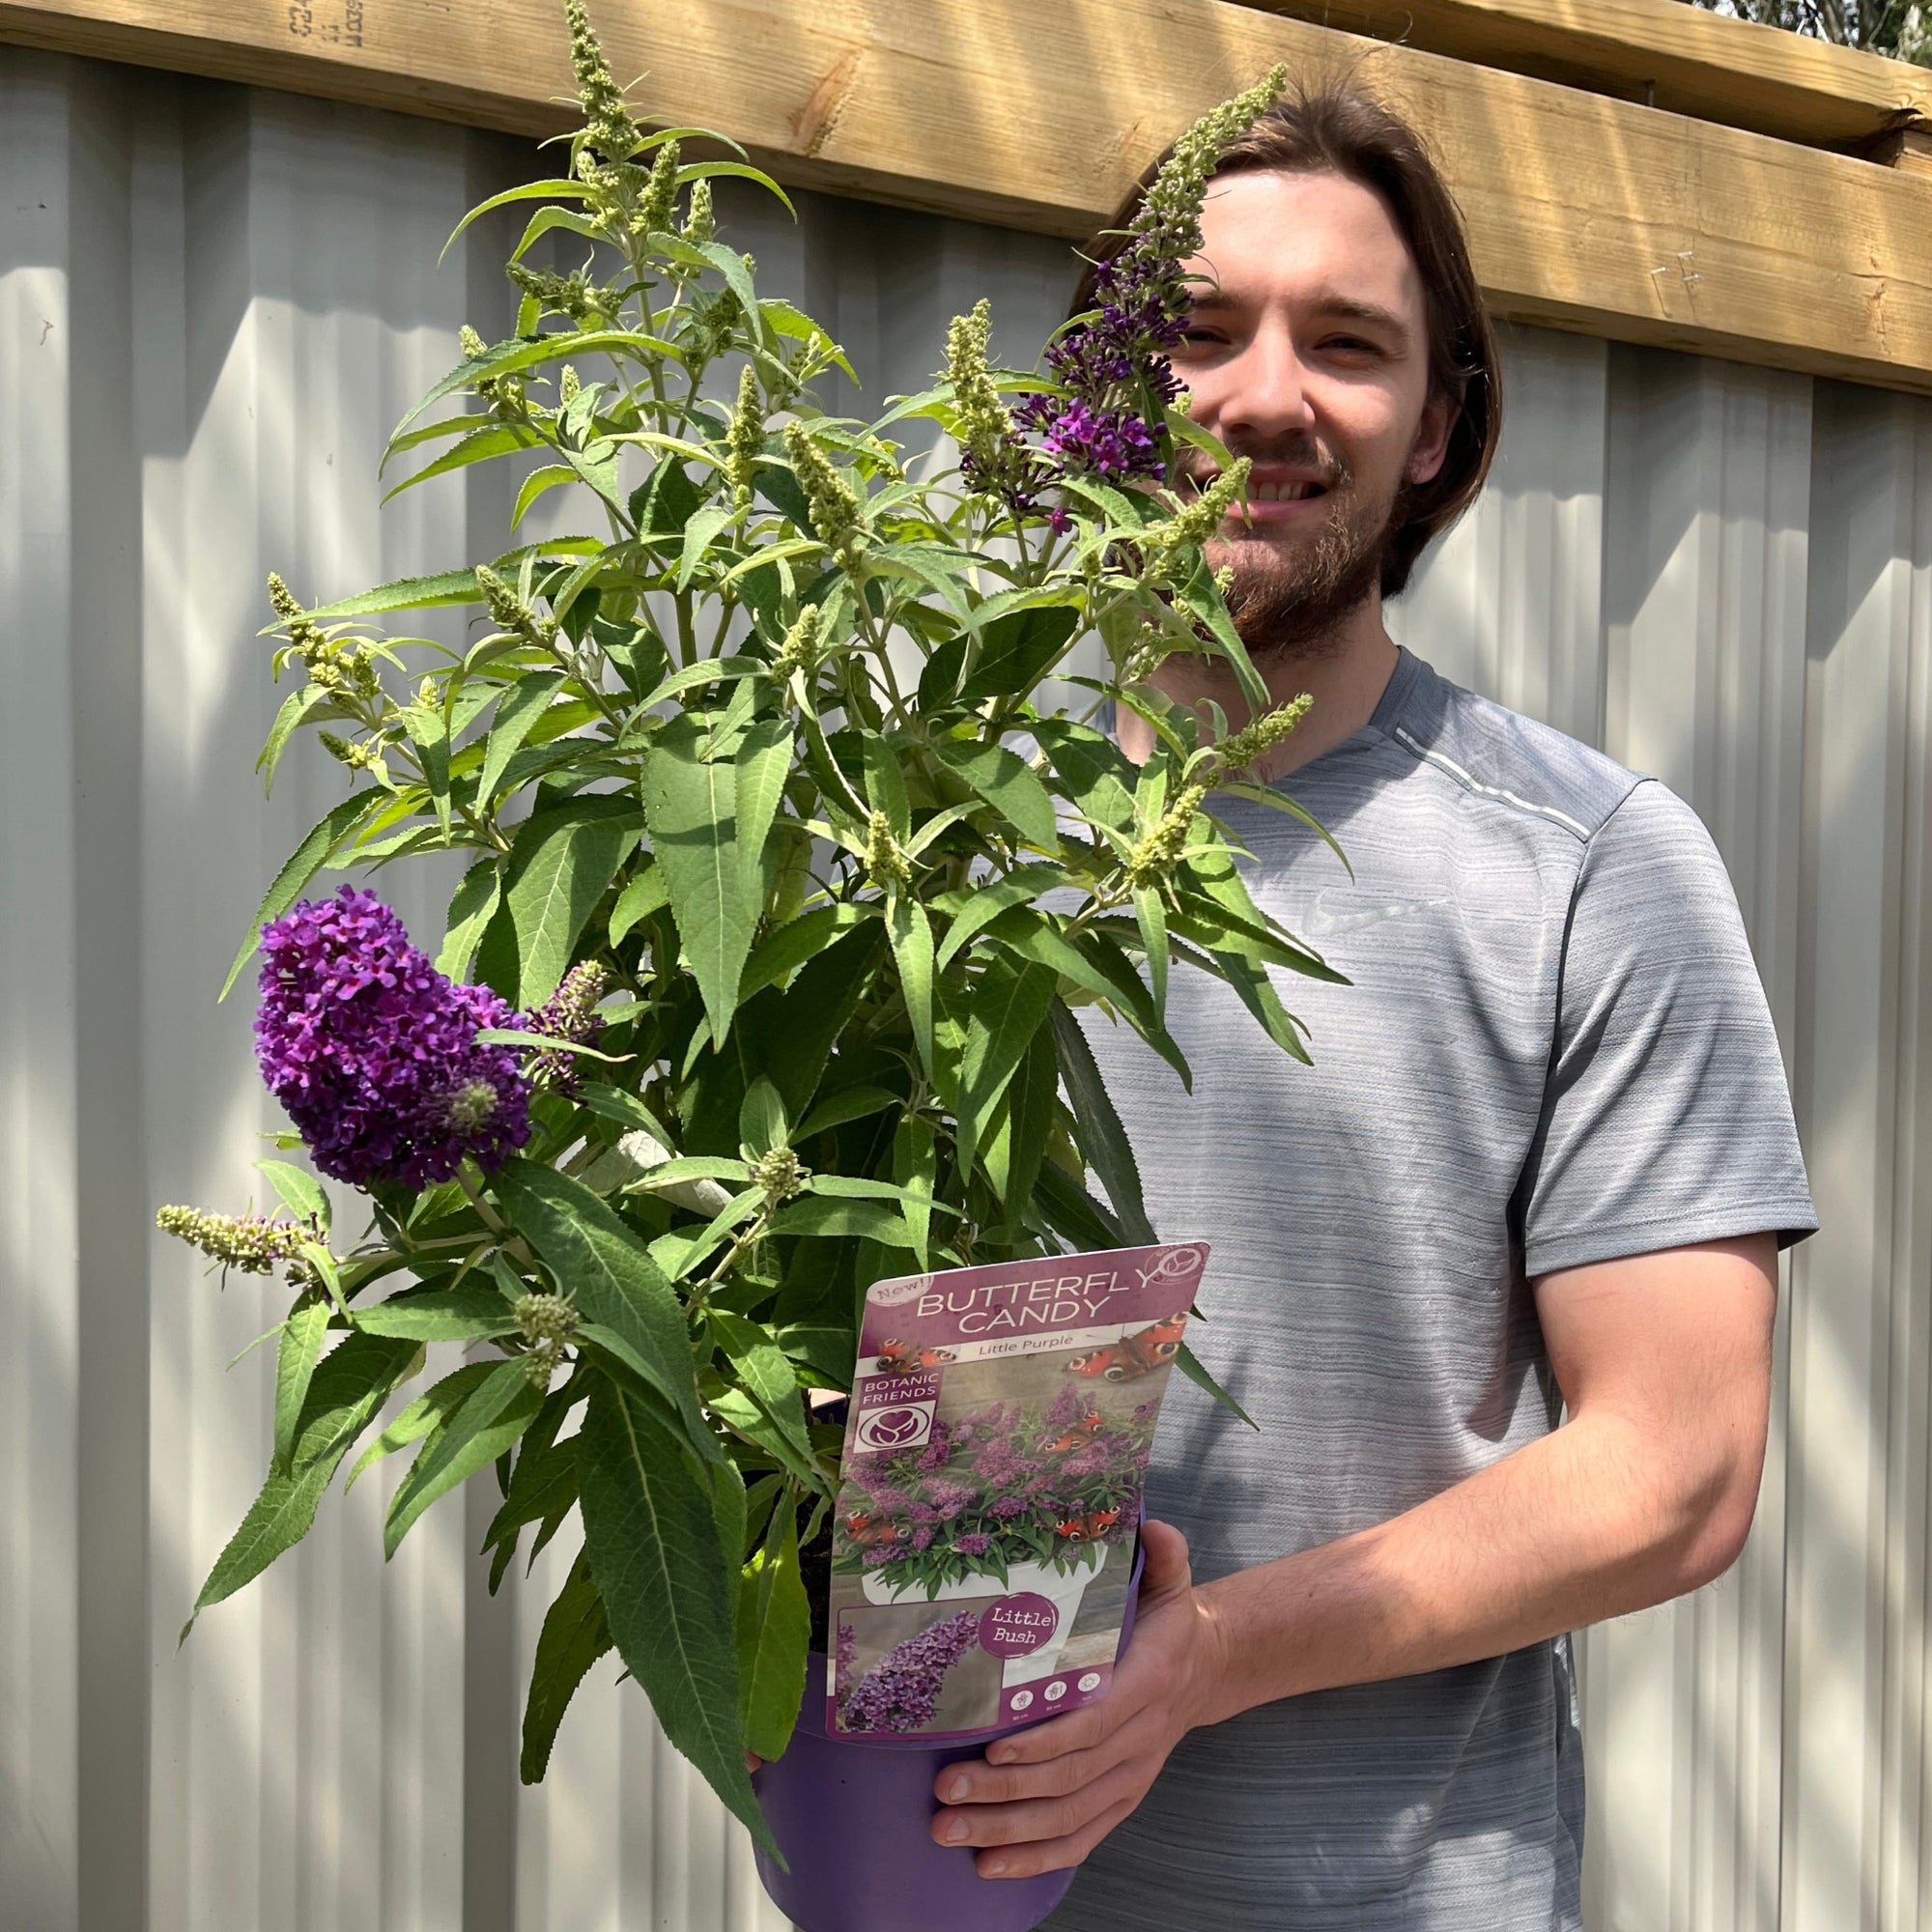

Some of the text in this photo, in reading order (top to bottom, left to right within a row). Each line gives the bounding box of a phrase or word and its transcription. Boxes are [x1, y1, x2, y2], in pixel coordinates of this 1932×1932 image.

[876, 1278, 928, 1300] New!
[917, 1266, 1159, 1318] BUTTERFLY
[957, 1296, 1110, 1334] CANDY
[978, 1333, 1074, 1356] Little Purple
[864, 1373, 938, 1394] BOTANIC
[863, 1385, 937, 1405] FRIENDS
[991, 1607, 1052, 1628] Little
[993, 1628, 1037, 1645] Bush
